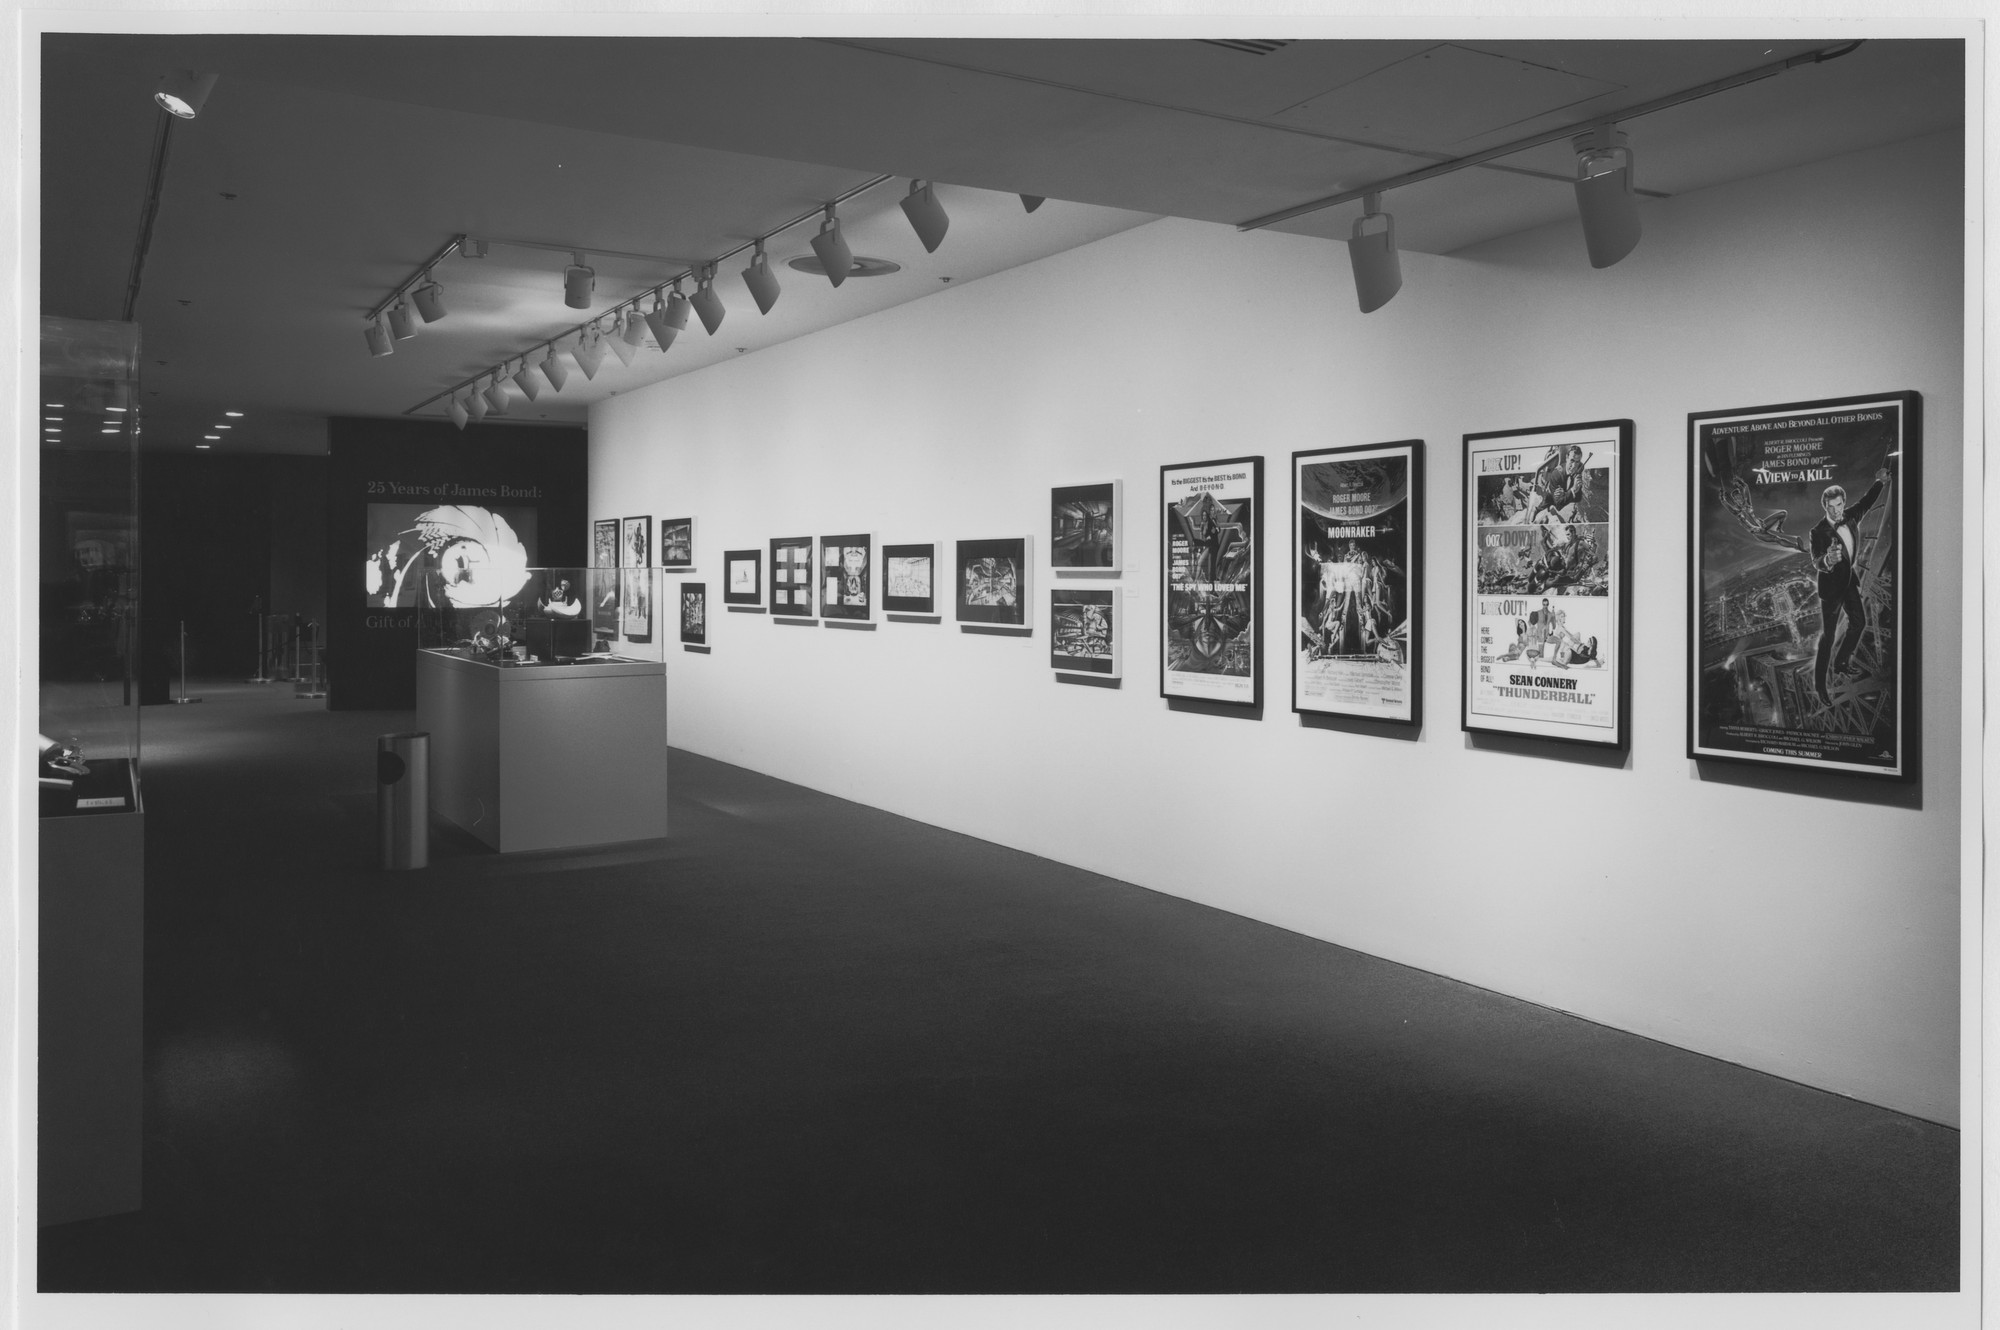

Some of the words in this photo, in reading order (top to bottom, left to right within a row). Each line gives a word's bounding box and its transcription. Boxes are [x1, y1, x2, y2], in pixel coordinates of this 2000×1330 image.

[1711, 426, 1749, 436] ADVENTURE
[1750, 424, 1772, 432] ABOVE
[1788, 420, 1816, 429] BEYOND
[1817, 418, 1831, 426] ALL
[1832, 416, 1855, 424] OTHER
[1857, 412, 1883, 422] BONDS
[1764, 444, 1792, 454] ROGER
[1793, 442, 1823, 452] MOORE
[1504, 455, 1521, 471] UP!
[1762, 460, 1786, 468] JAMES
[1787, 458, 1809, 467] BOND
[1183, 477, 1202, 485] BIGGEST
[1756, 473, 1763, 484] A
[1763, 471, 1791, 484] VIEW
[1799, 471, 1806, 482] A
[1807, 469, 1833, 482] KILL
[368, 481, 386, 494] 25
[390, 481, 431, 495] Years
[433, 483, 449, 496] of
[451, 483, 497, 497] James
[500, 485, 543, 499] Bond:
[1333, 494, 1350, 504] ROGER
[1352, 493, 1371, 502] MOORE
[1329, 506, 1347, 516] JAMES
[1348, 505, 1363, 515] BOND
[1328, 526, 1376, 539] MOONRAKER
[1504, 530, 1537, 547] DOWN!
[1185, 583, 1197, 591] SPY
[1198, 583, 1213, 591] WHO
[1214, 583, 1235, 592] LOVED
[1504, 600, 1528, 616] OUT!
[366, 615, 394, 629] Gift
[398, 615, 413, 630] of
[1510, 674, 1533, 687] SEAN
[1535, 677, 1578, 690] CONNERY
[1493, 686, 1596, 705] "THUNDERBALL"
[1763, 747, 1785, 755] COMING
[1798, 751, 1823, 759] SUMMER
